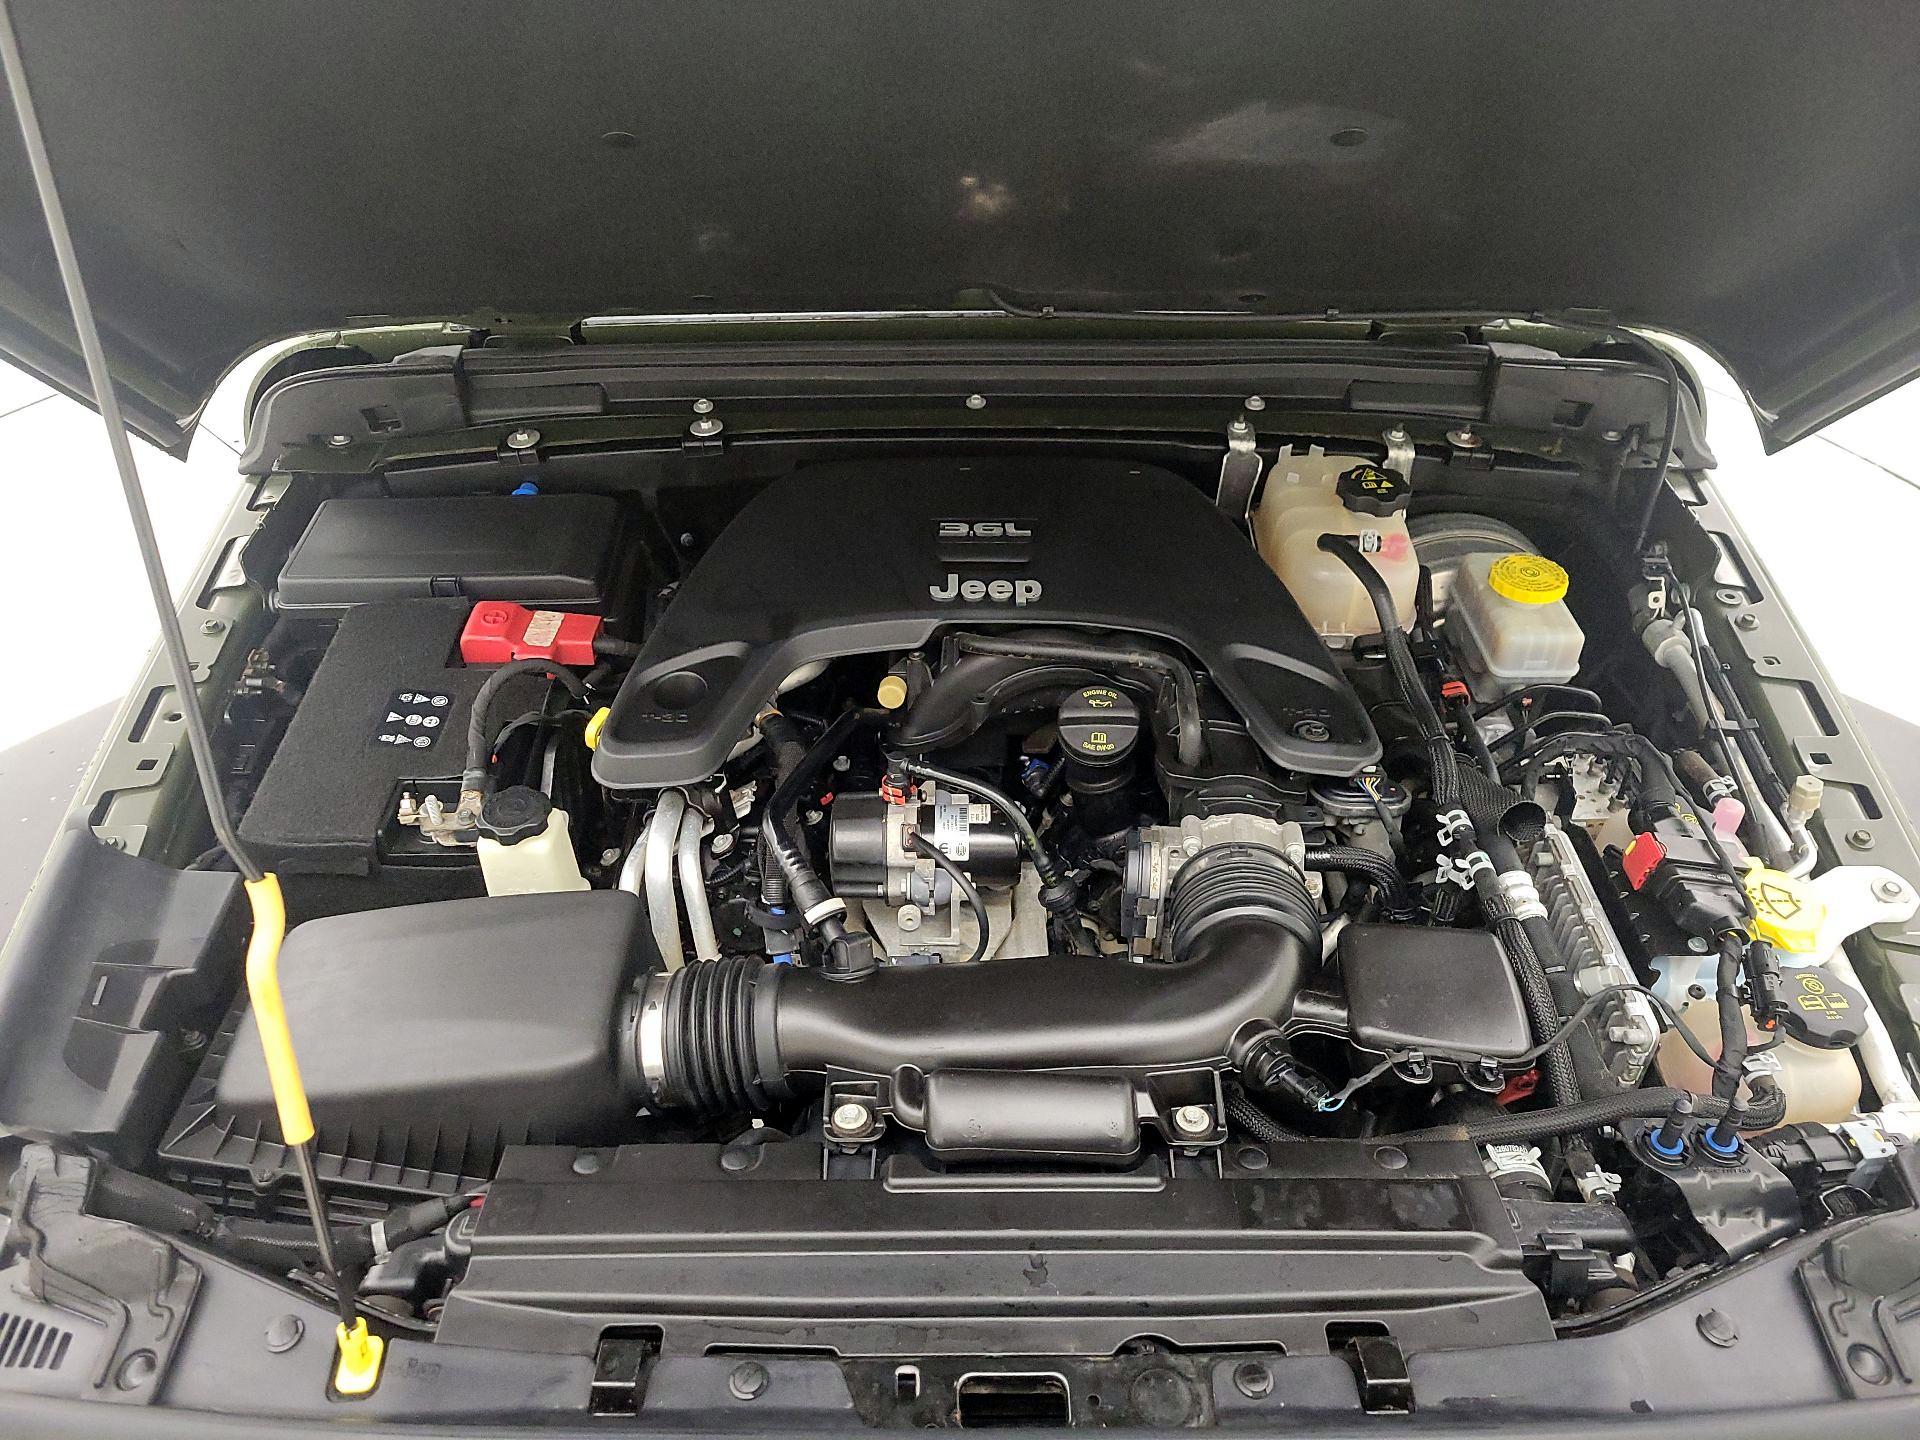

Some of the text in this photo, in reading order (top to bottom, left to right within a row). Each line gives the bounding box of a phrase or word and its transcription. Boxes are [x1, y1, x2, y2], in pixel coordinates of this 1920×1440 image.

[938, 522, 1032, 537] 3.6L
[929, 573, 1043, 607] Jeep
[1082, 689, 1119, 700] ENGINE OIL
[1082, 741, 1115, 752] SAE 0W-20
